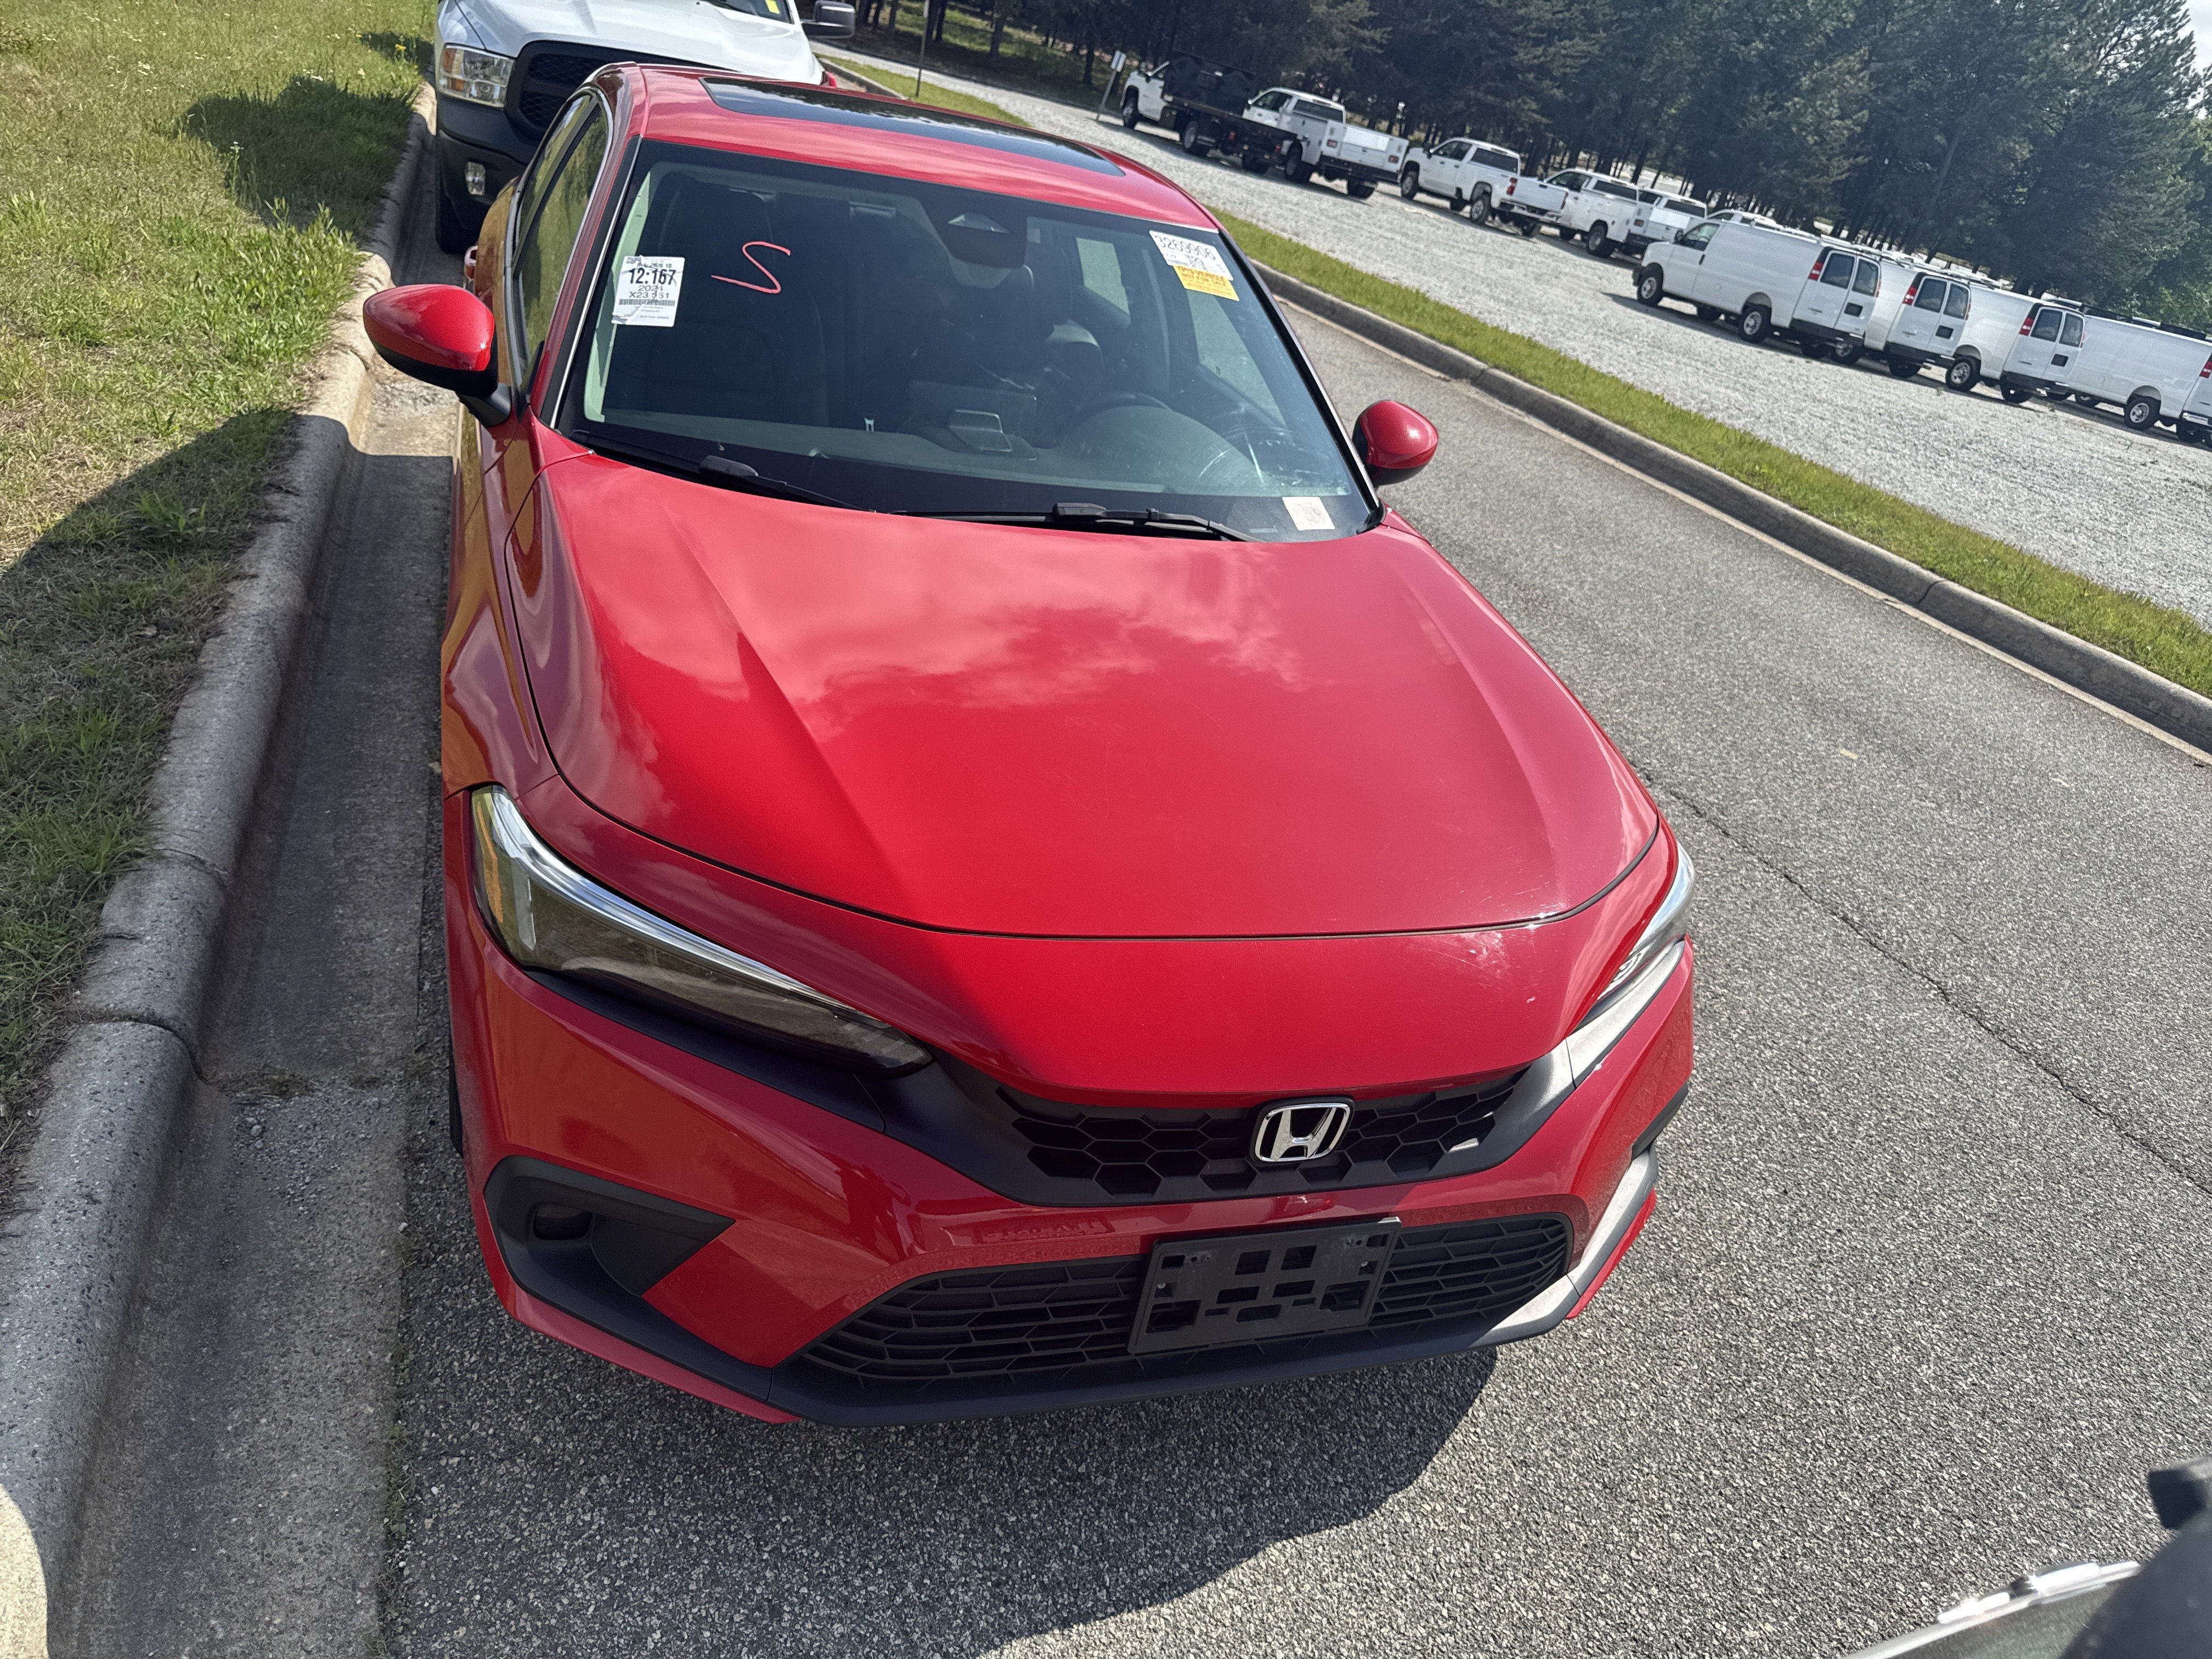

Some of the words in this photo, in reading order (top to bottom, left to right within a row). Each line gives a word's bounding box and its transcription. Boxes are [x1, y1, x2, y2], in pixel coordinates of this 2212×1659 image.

[1154, 235, 1216, 260] 3269906
[629, 268, 676, 285] 12:167
[711, 241, 791, 294] S
[1195, 269, 1224, 282] VEHICLE
